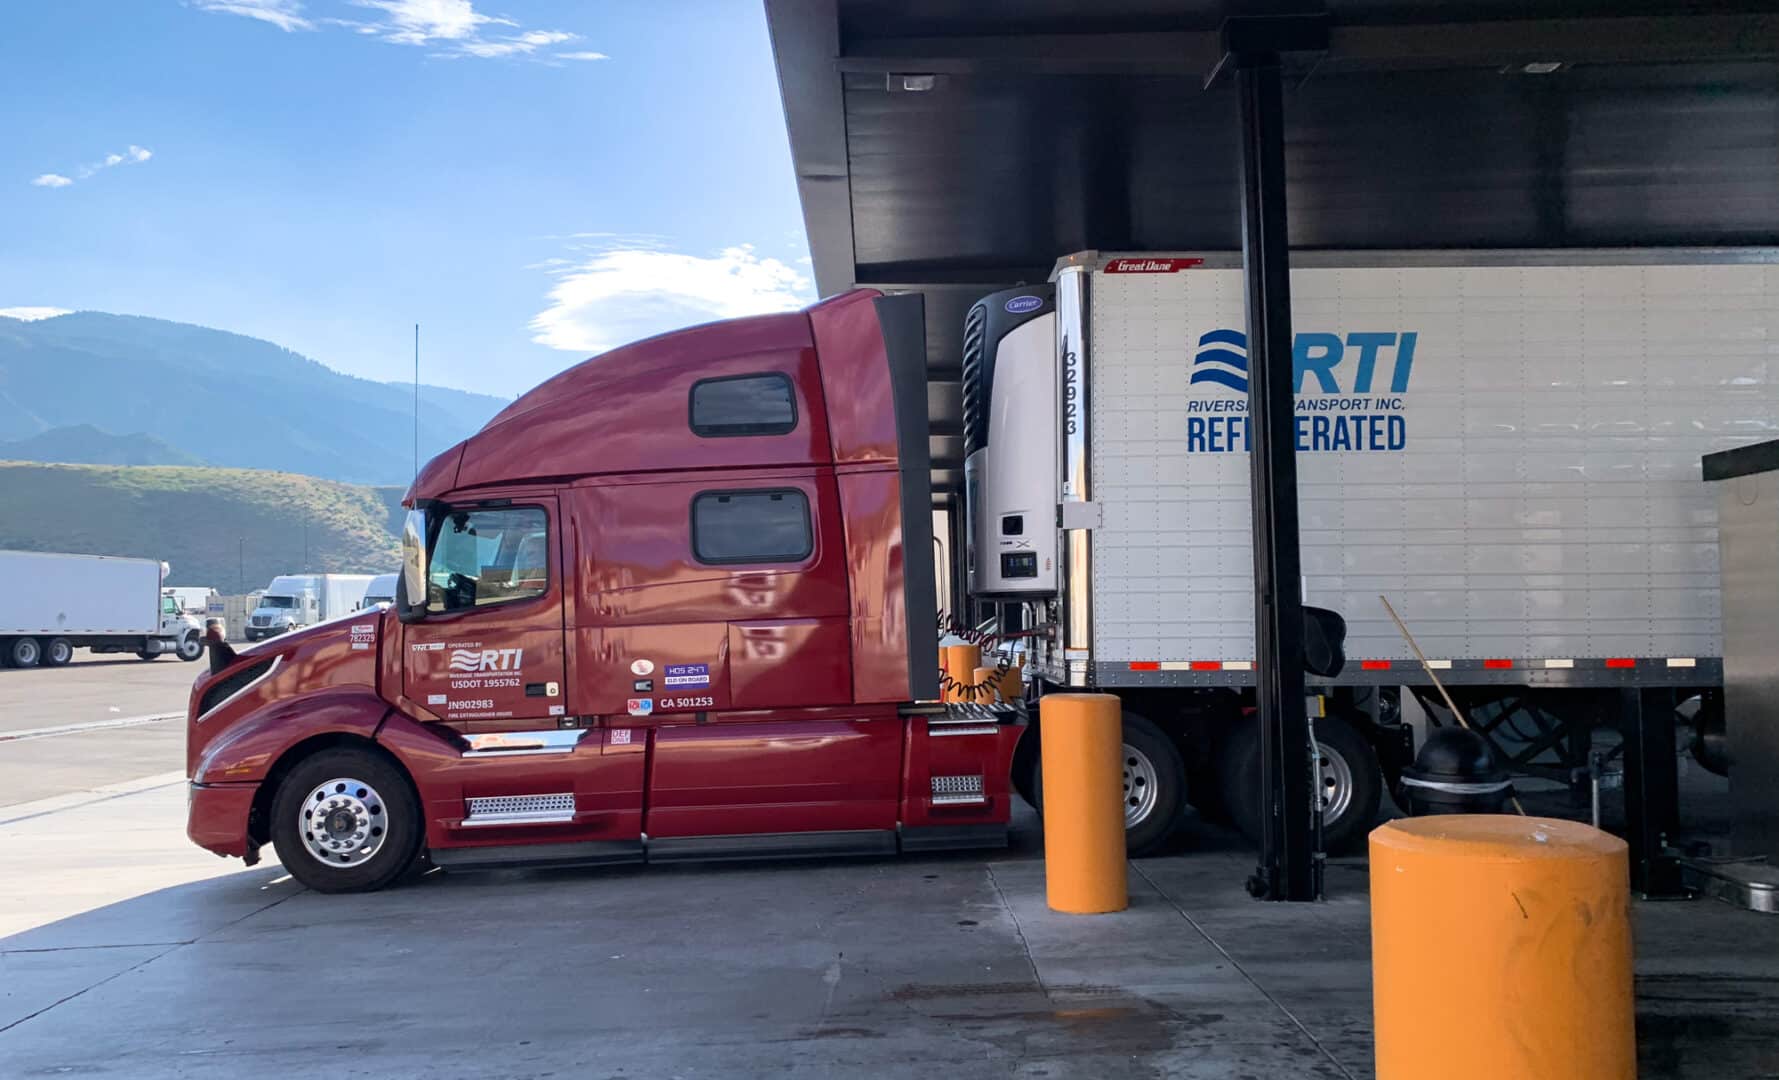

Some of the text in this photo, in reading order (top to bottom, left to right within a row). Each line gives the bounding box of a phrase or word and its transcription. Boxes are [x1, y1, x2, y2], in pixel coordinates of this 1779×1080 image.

[1118, 260, 1172, 272] Great Dane
[1008, 299, 1038, 309] Carrier
[1292, 332, 1418, 394] RTI
[1066, 352, 1077, 435] 32923
[1295, 399, 1370, 411] ANSPORT
[1375, 398, 1406, 411] INC.
[479, 648, 523, 671] RTI
[669, 667, 685, 675] HOS
[451, 678, 521, 689] USDOT 1955762
[660, 698, 675, 708] CA
[677, 697, 713, 707] 501253
